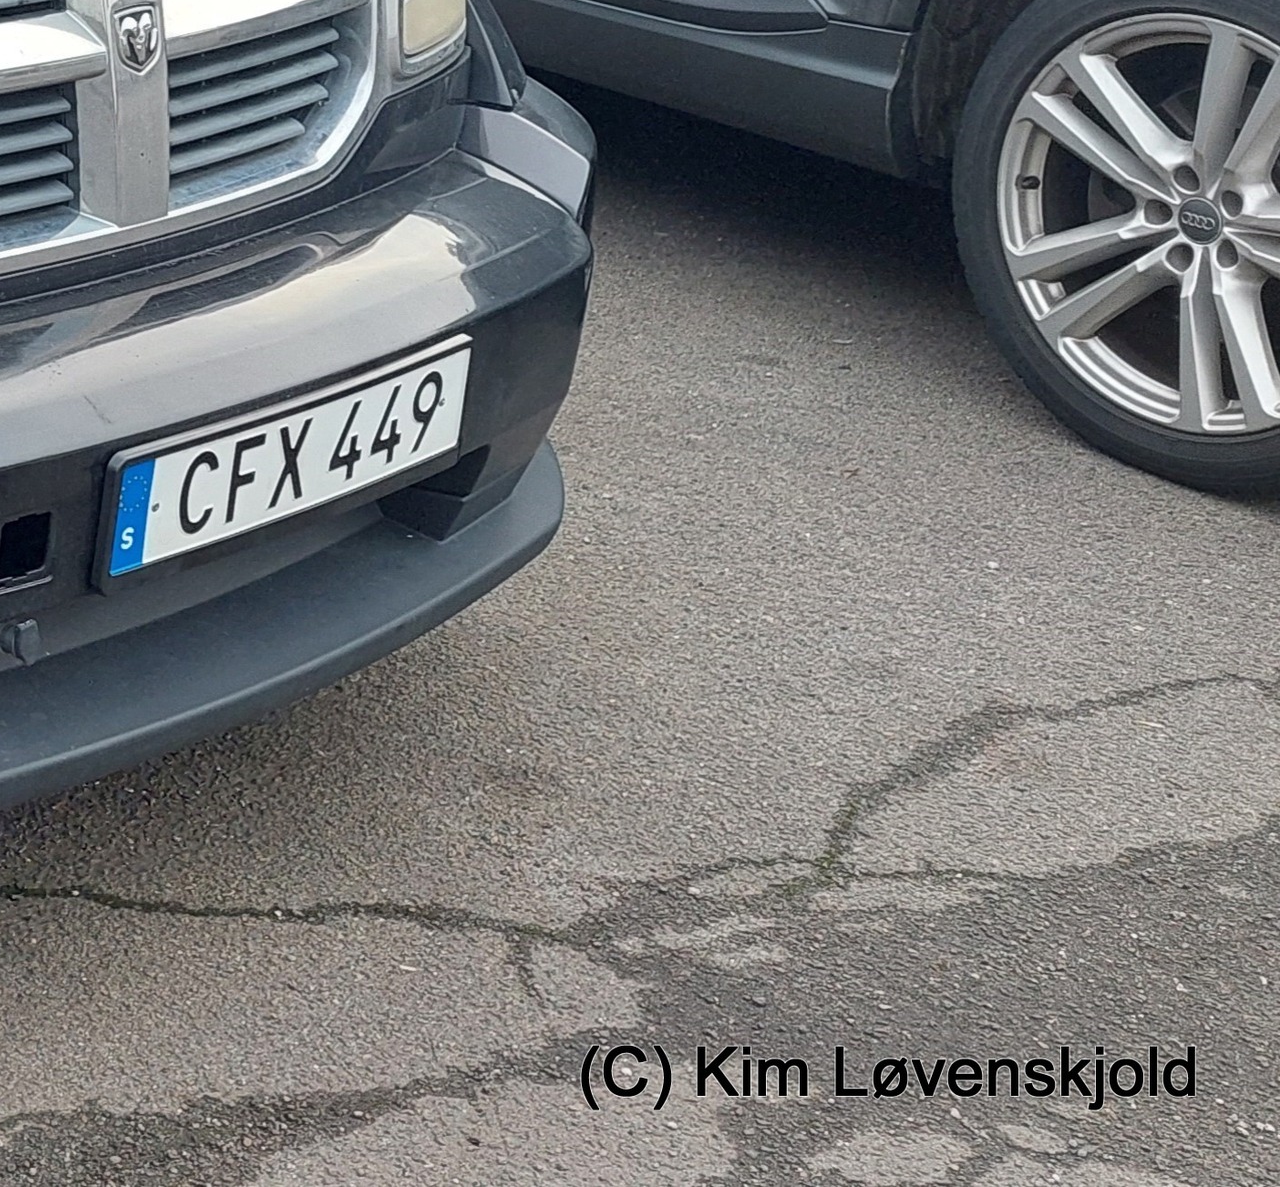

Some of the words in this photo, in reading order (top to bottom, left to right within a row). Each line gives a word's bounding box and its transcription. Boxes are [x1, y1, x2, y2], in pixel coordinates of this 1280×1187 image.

[178, 417, 313, 535] CFX
[328, 370, 443, 481] 449
[120, 526, 135, 550] S
